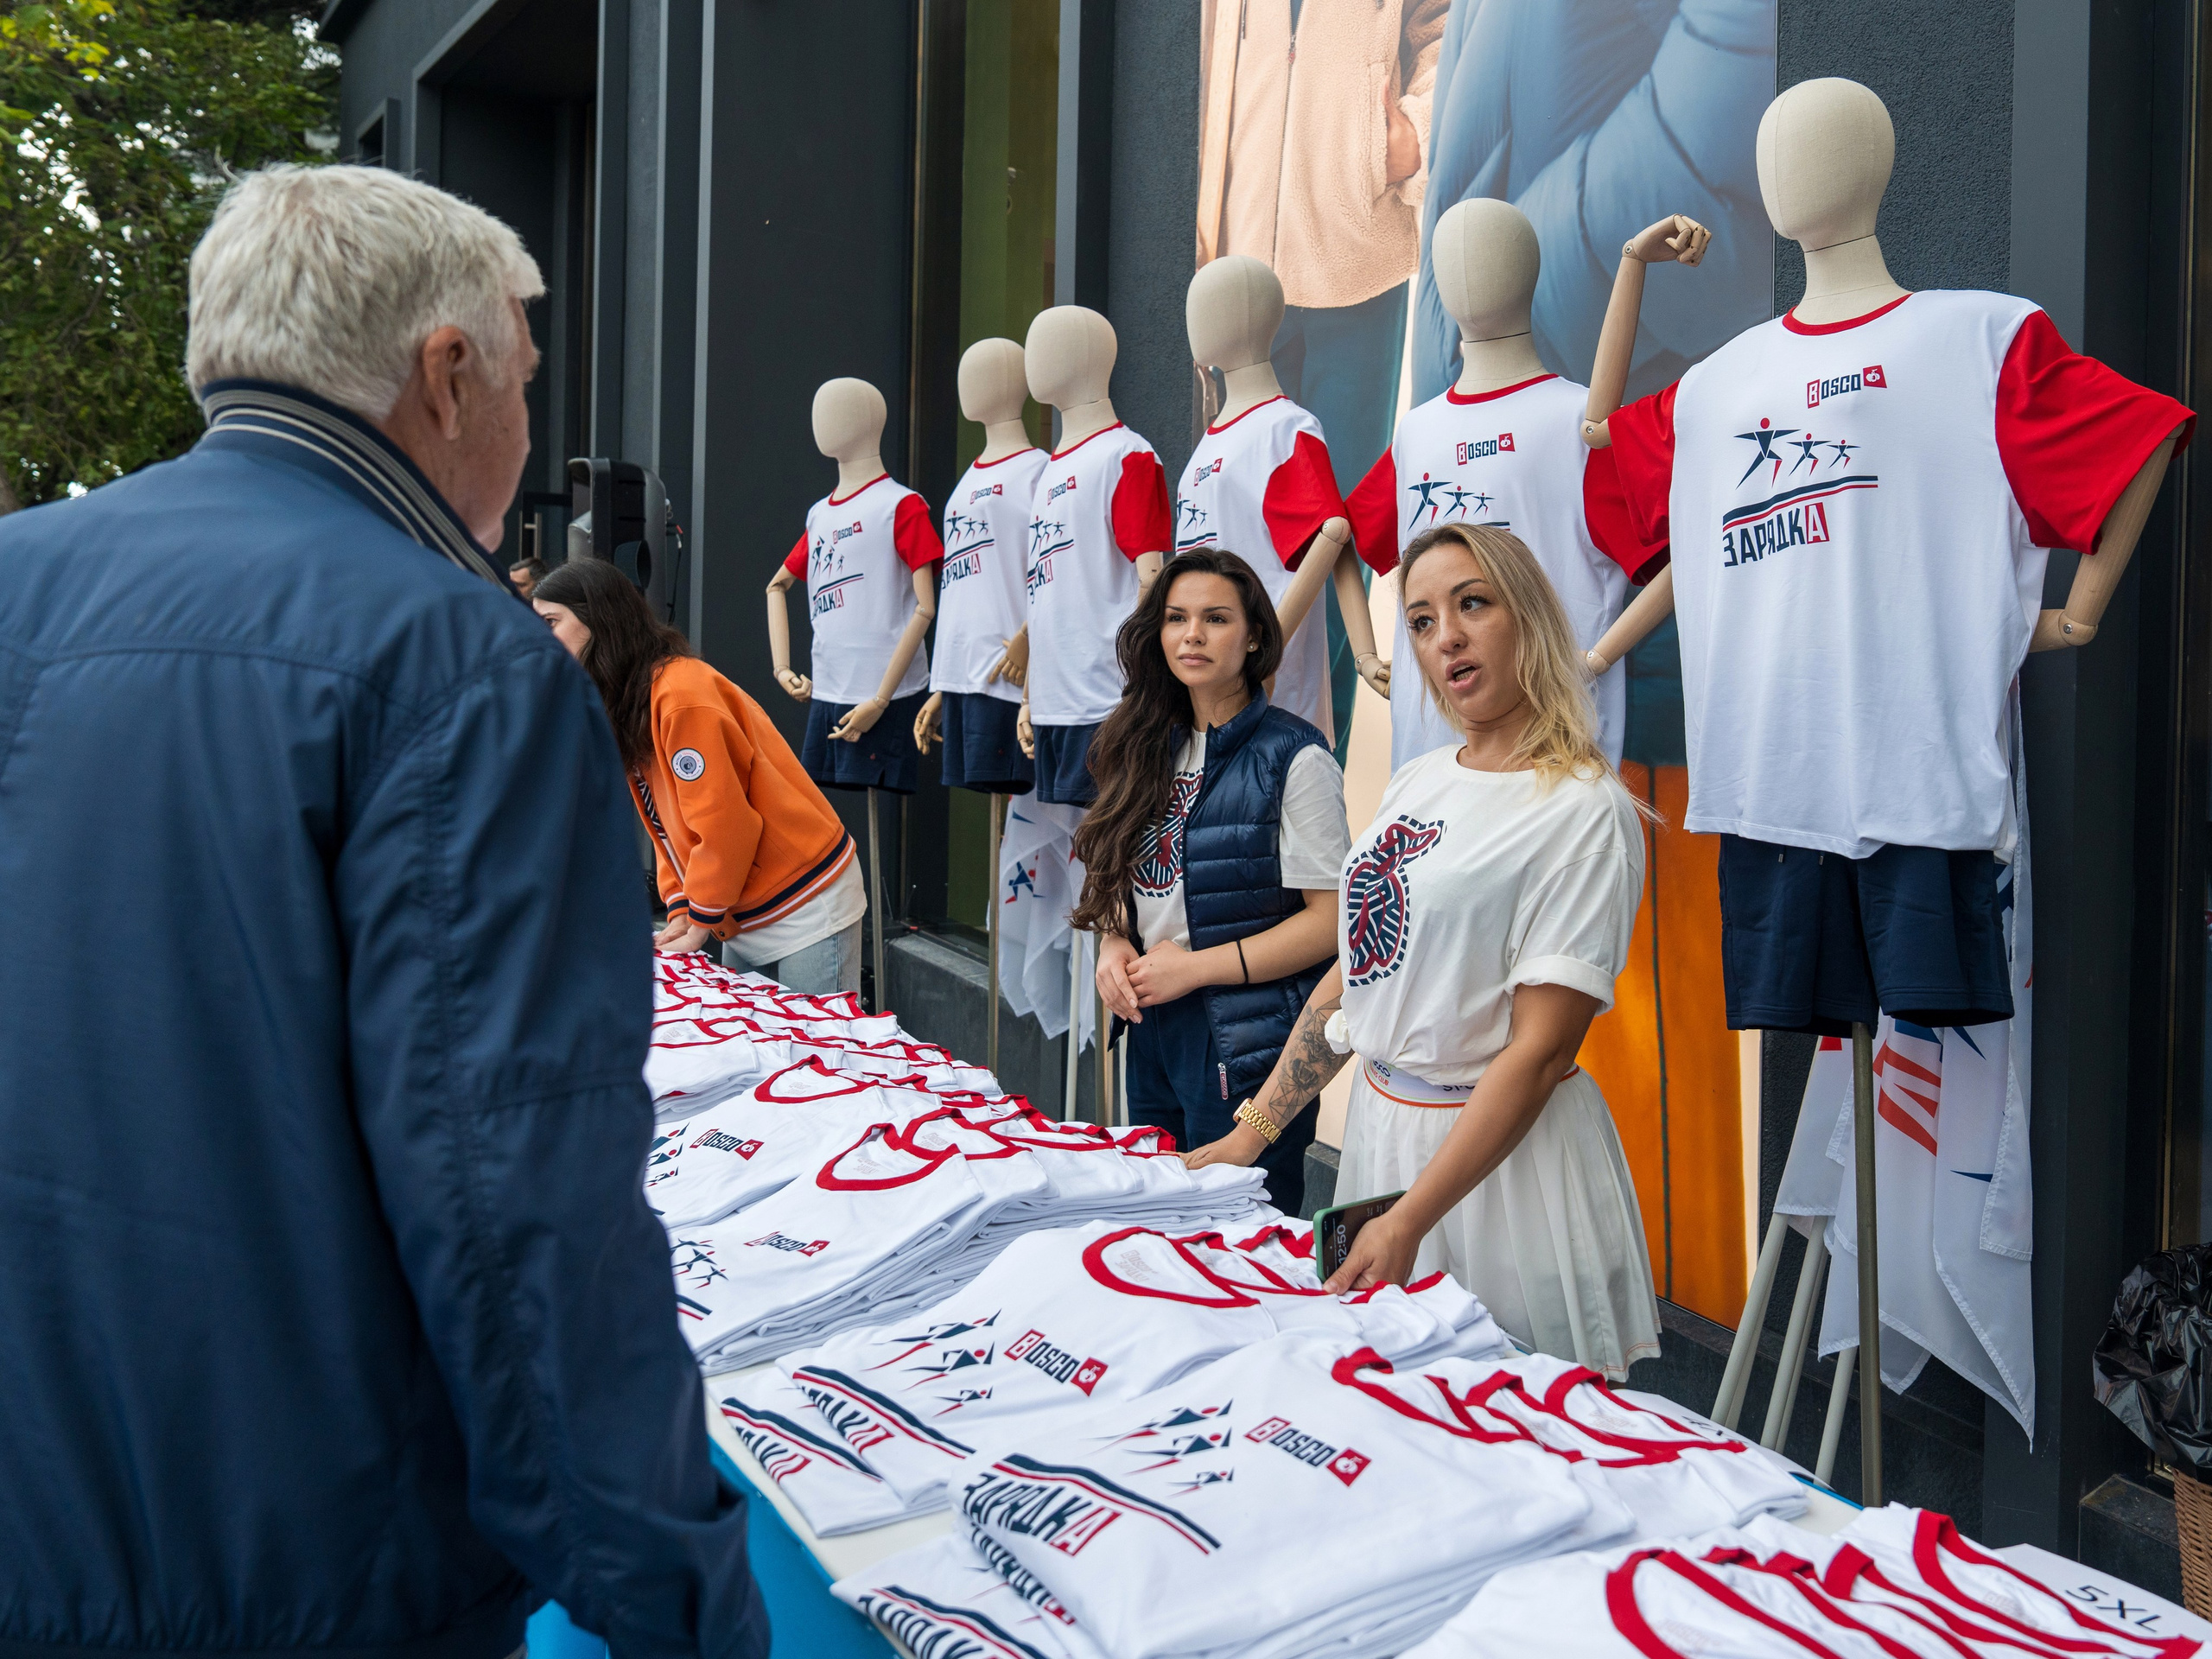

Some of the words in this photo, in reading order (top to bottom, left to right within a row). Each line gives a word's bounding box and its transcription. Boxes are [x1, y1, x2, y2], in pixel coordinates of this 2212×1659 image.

[1807, 373, 1861, 409] BOSCO
[1457, 440, 1497, 466] BOSCO
[1723, 502, 1830, 568] ЗАРЯДКА
[689, 1128, 745, 1152] BOSCO
[1004, 1329, 1080, 1383] BOSCO
[1244, 1415, 1337, 1467] BOSCO
[2065, 1585, 2162, 1632] 5XL
